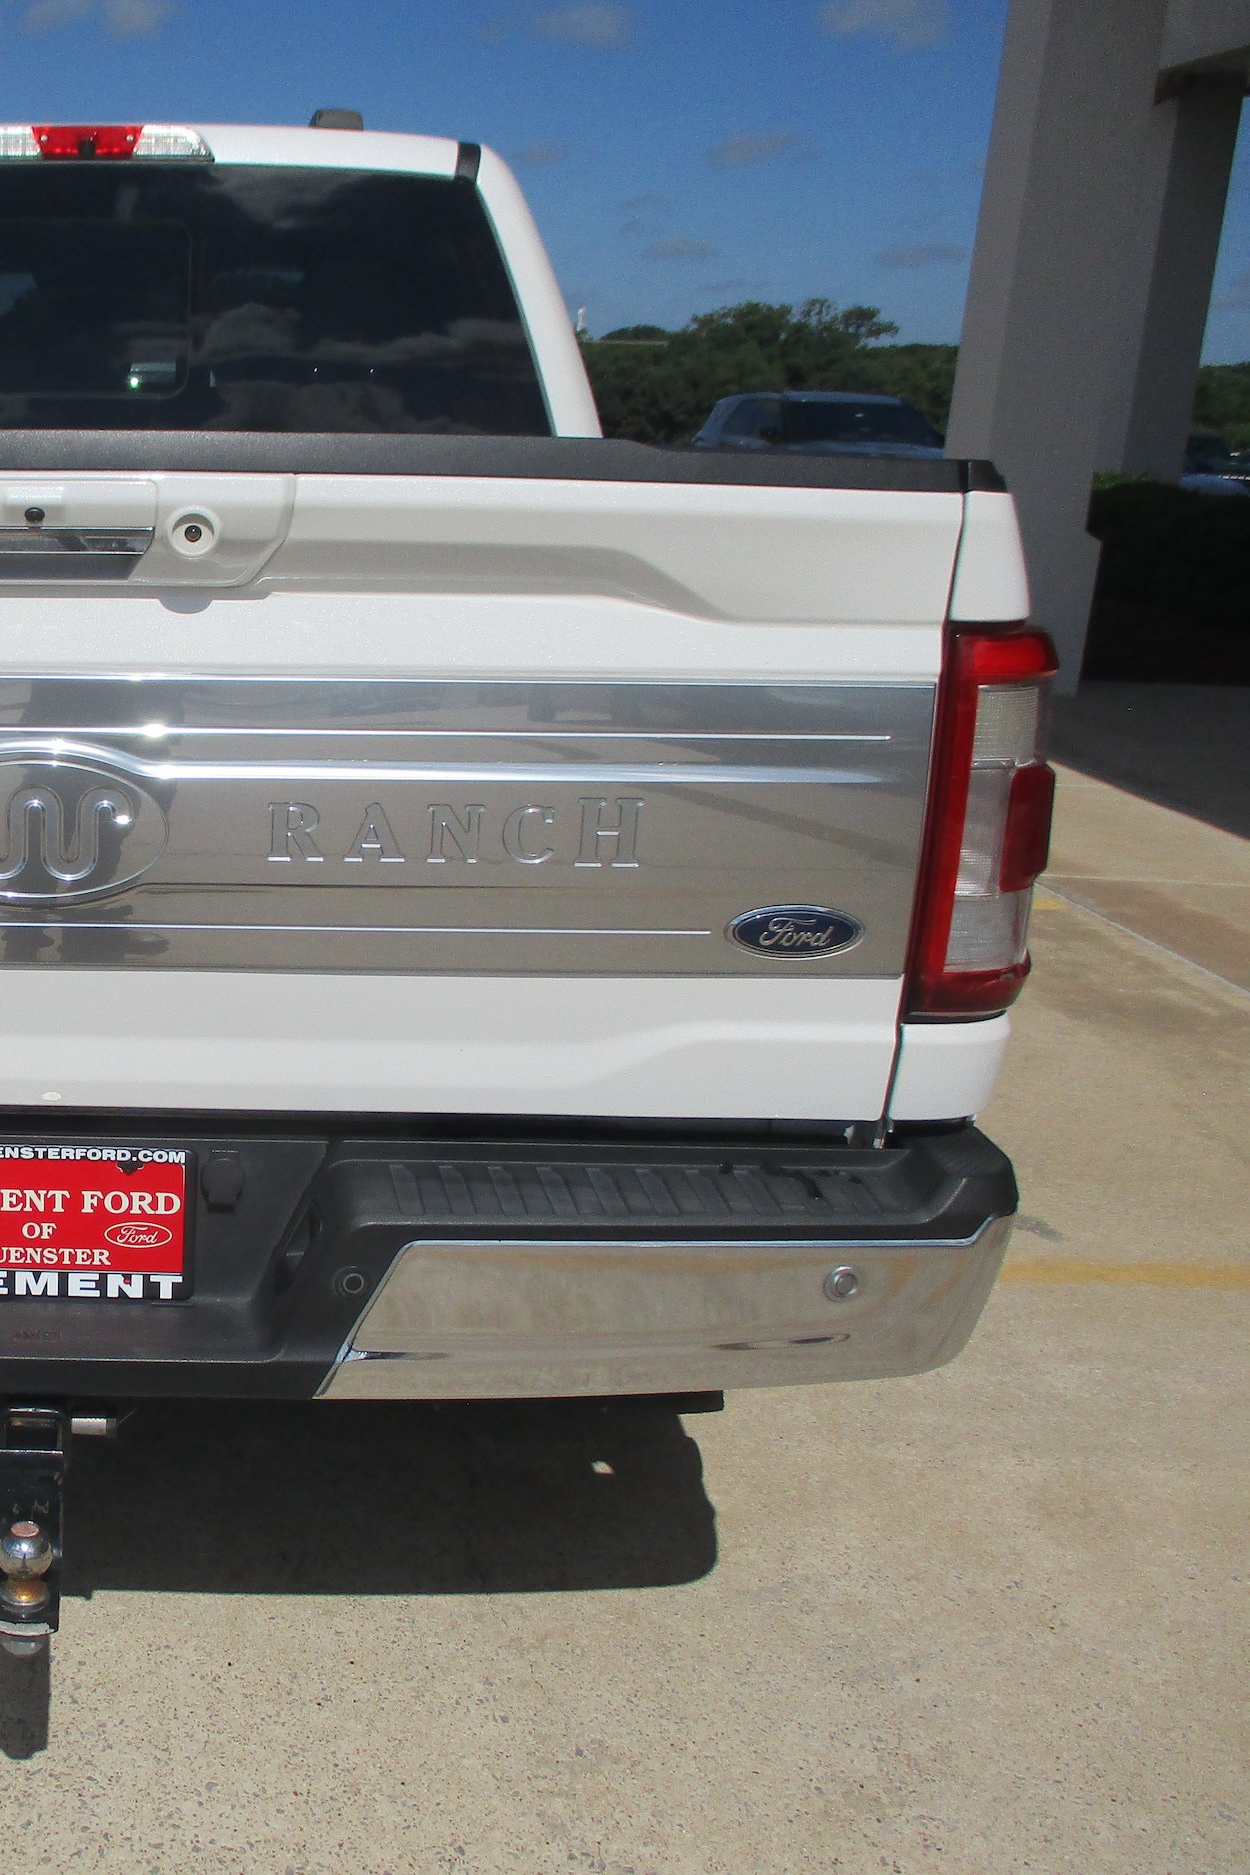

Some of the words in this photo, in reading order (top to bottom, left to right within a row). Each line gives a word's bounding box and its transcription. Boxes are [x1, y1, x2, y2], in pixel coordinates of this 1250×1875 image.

[266, 797, 644, 868] RANCH
[759, 917, 833, 947] Ford
[81, 1191, 181, 1215] FORD
[22, 1222, 57, 1240] OF
[117, 1226, 158, 1245] Ford
